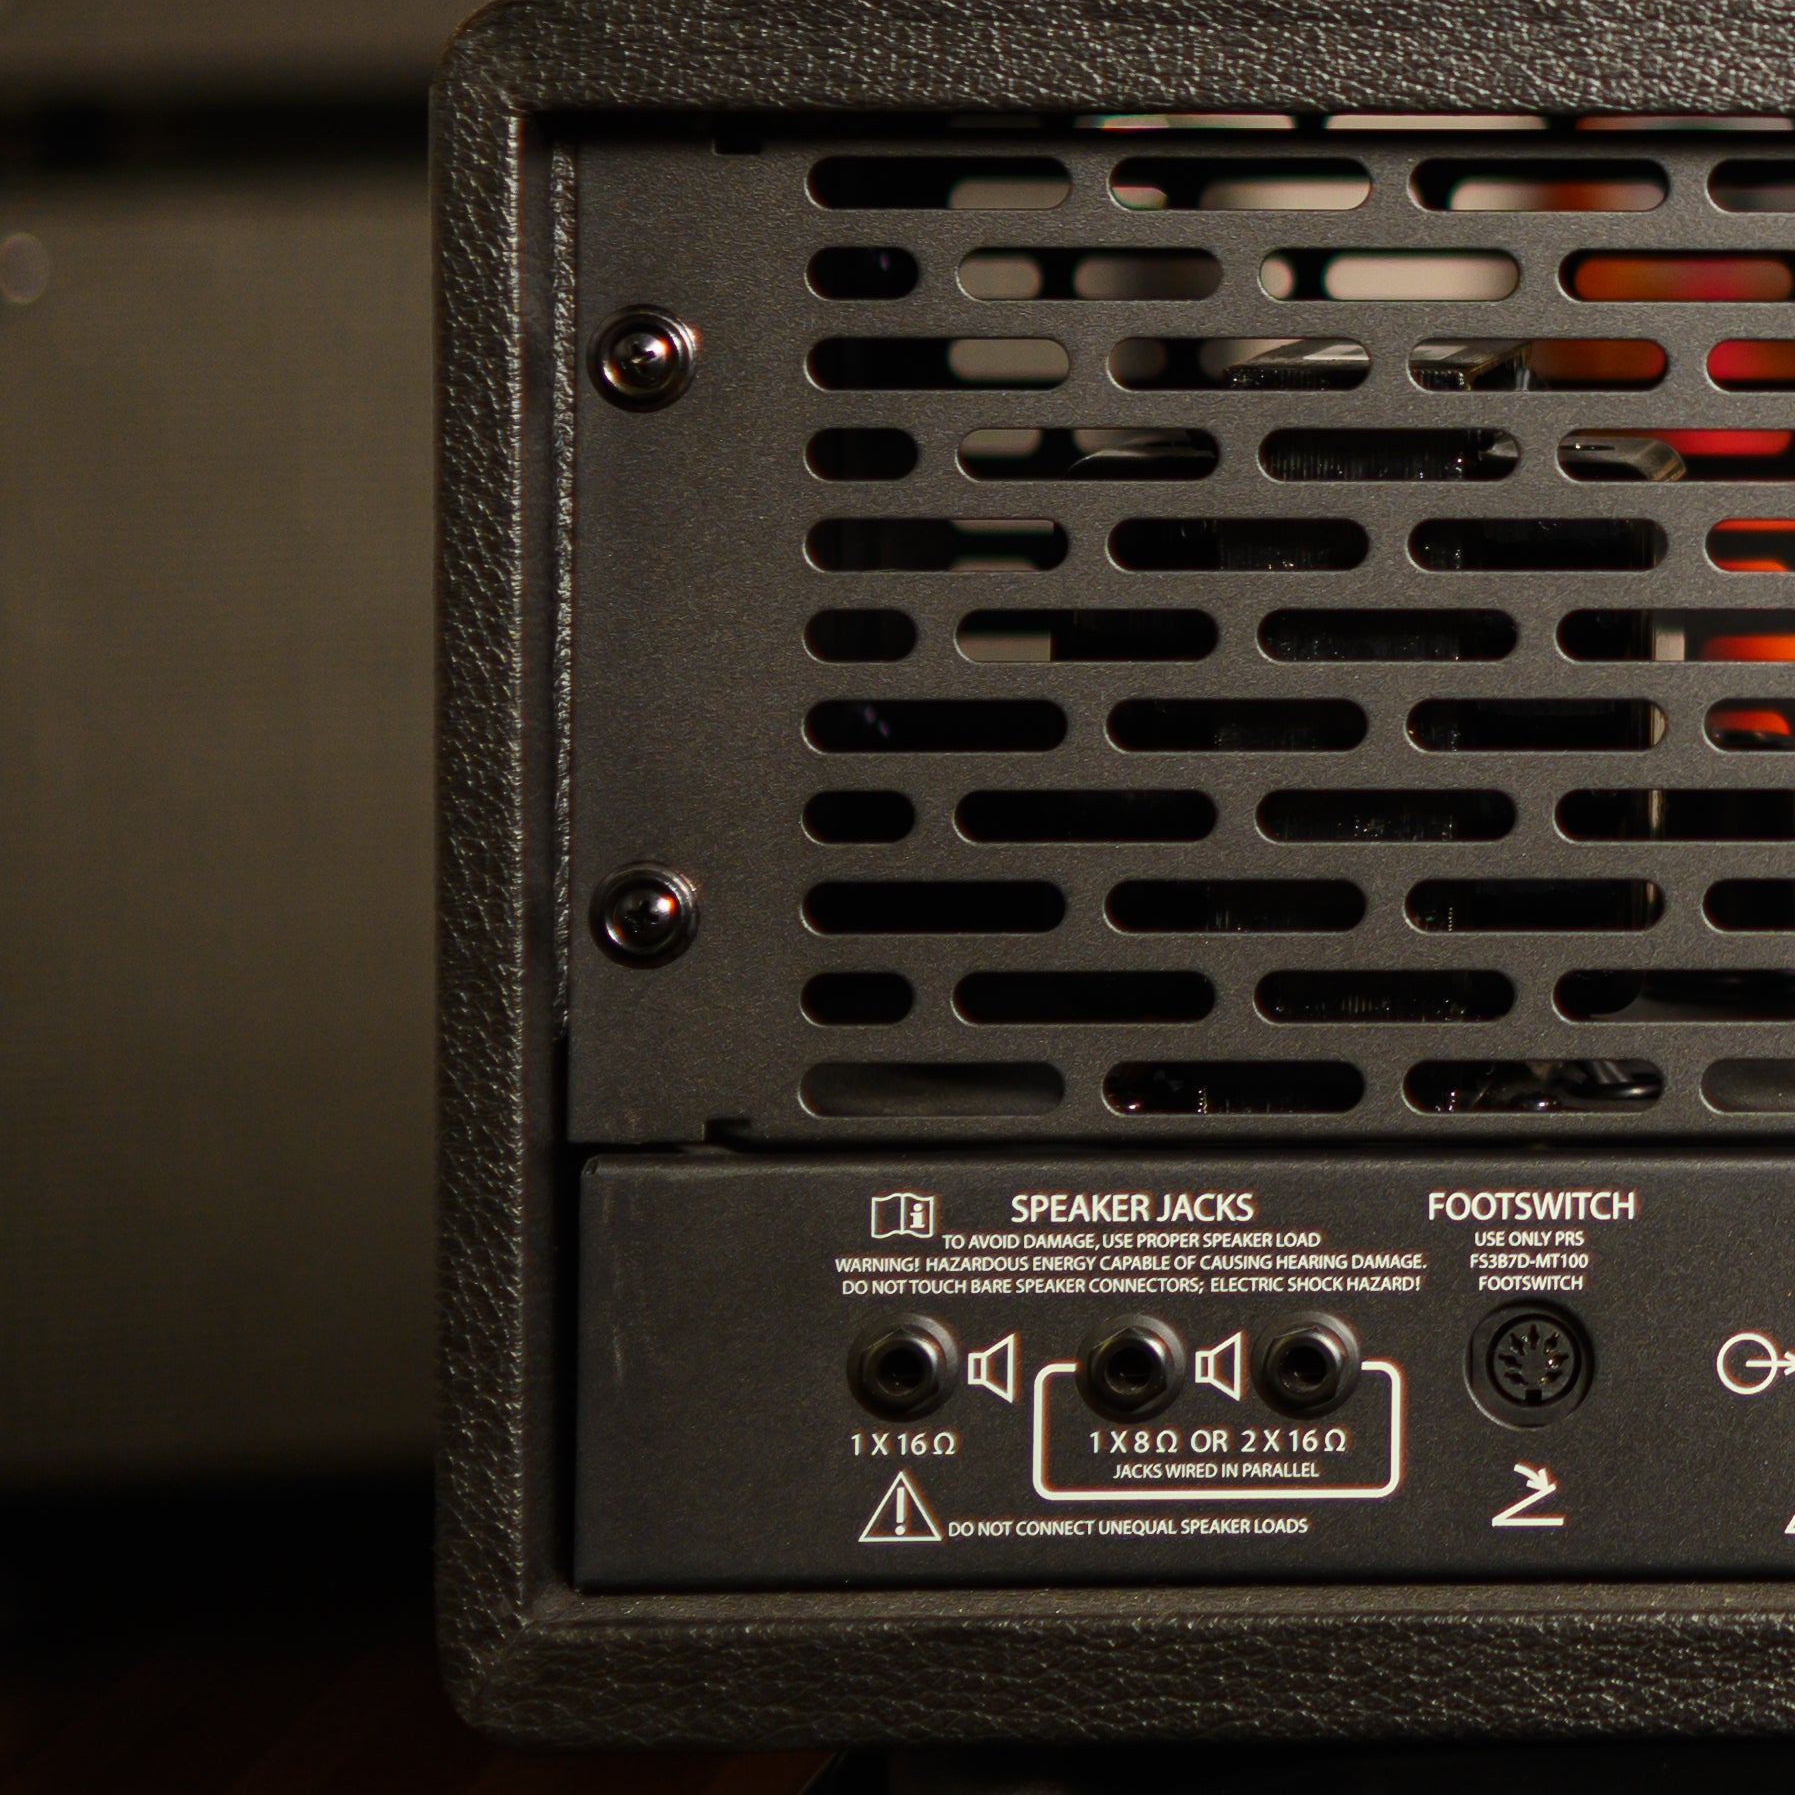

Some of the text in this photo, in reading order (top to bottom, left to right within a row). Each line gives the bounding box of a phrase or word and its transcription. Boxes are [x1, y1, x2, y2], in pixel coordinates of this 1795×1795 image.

[1011, 1192, 1255, 1223] SPEAKER JACKS
[1428, 1191, 1635, 1221] FOOTSWITCH
[942, 1231, 1322, 1251] TO AVOID DAMAGE, USE PROPER SPEAKER LOAD
[1474, 1230, 1585, 1247] USE ONLY PRS
[834, 1253, 1427, 1273] WARNING! HAZARDOUS ENERGY CAPABLE OF CAUSING HEARING DAMAGE.
[1470, 1252, 1589, 1270] FS3B7D-MT100
[1478, 1274, 1584, 1292] FOOTSWITCH
[1190, 1429, 1228, 1453] OR
[1112, 1462, 1320, 1479] JACKS WIRED IN PARALLEL
[948, 1517, 1309, 1537] DO NOT CONNECT UNEQUAL SPEAKER LOADS
